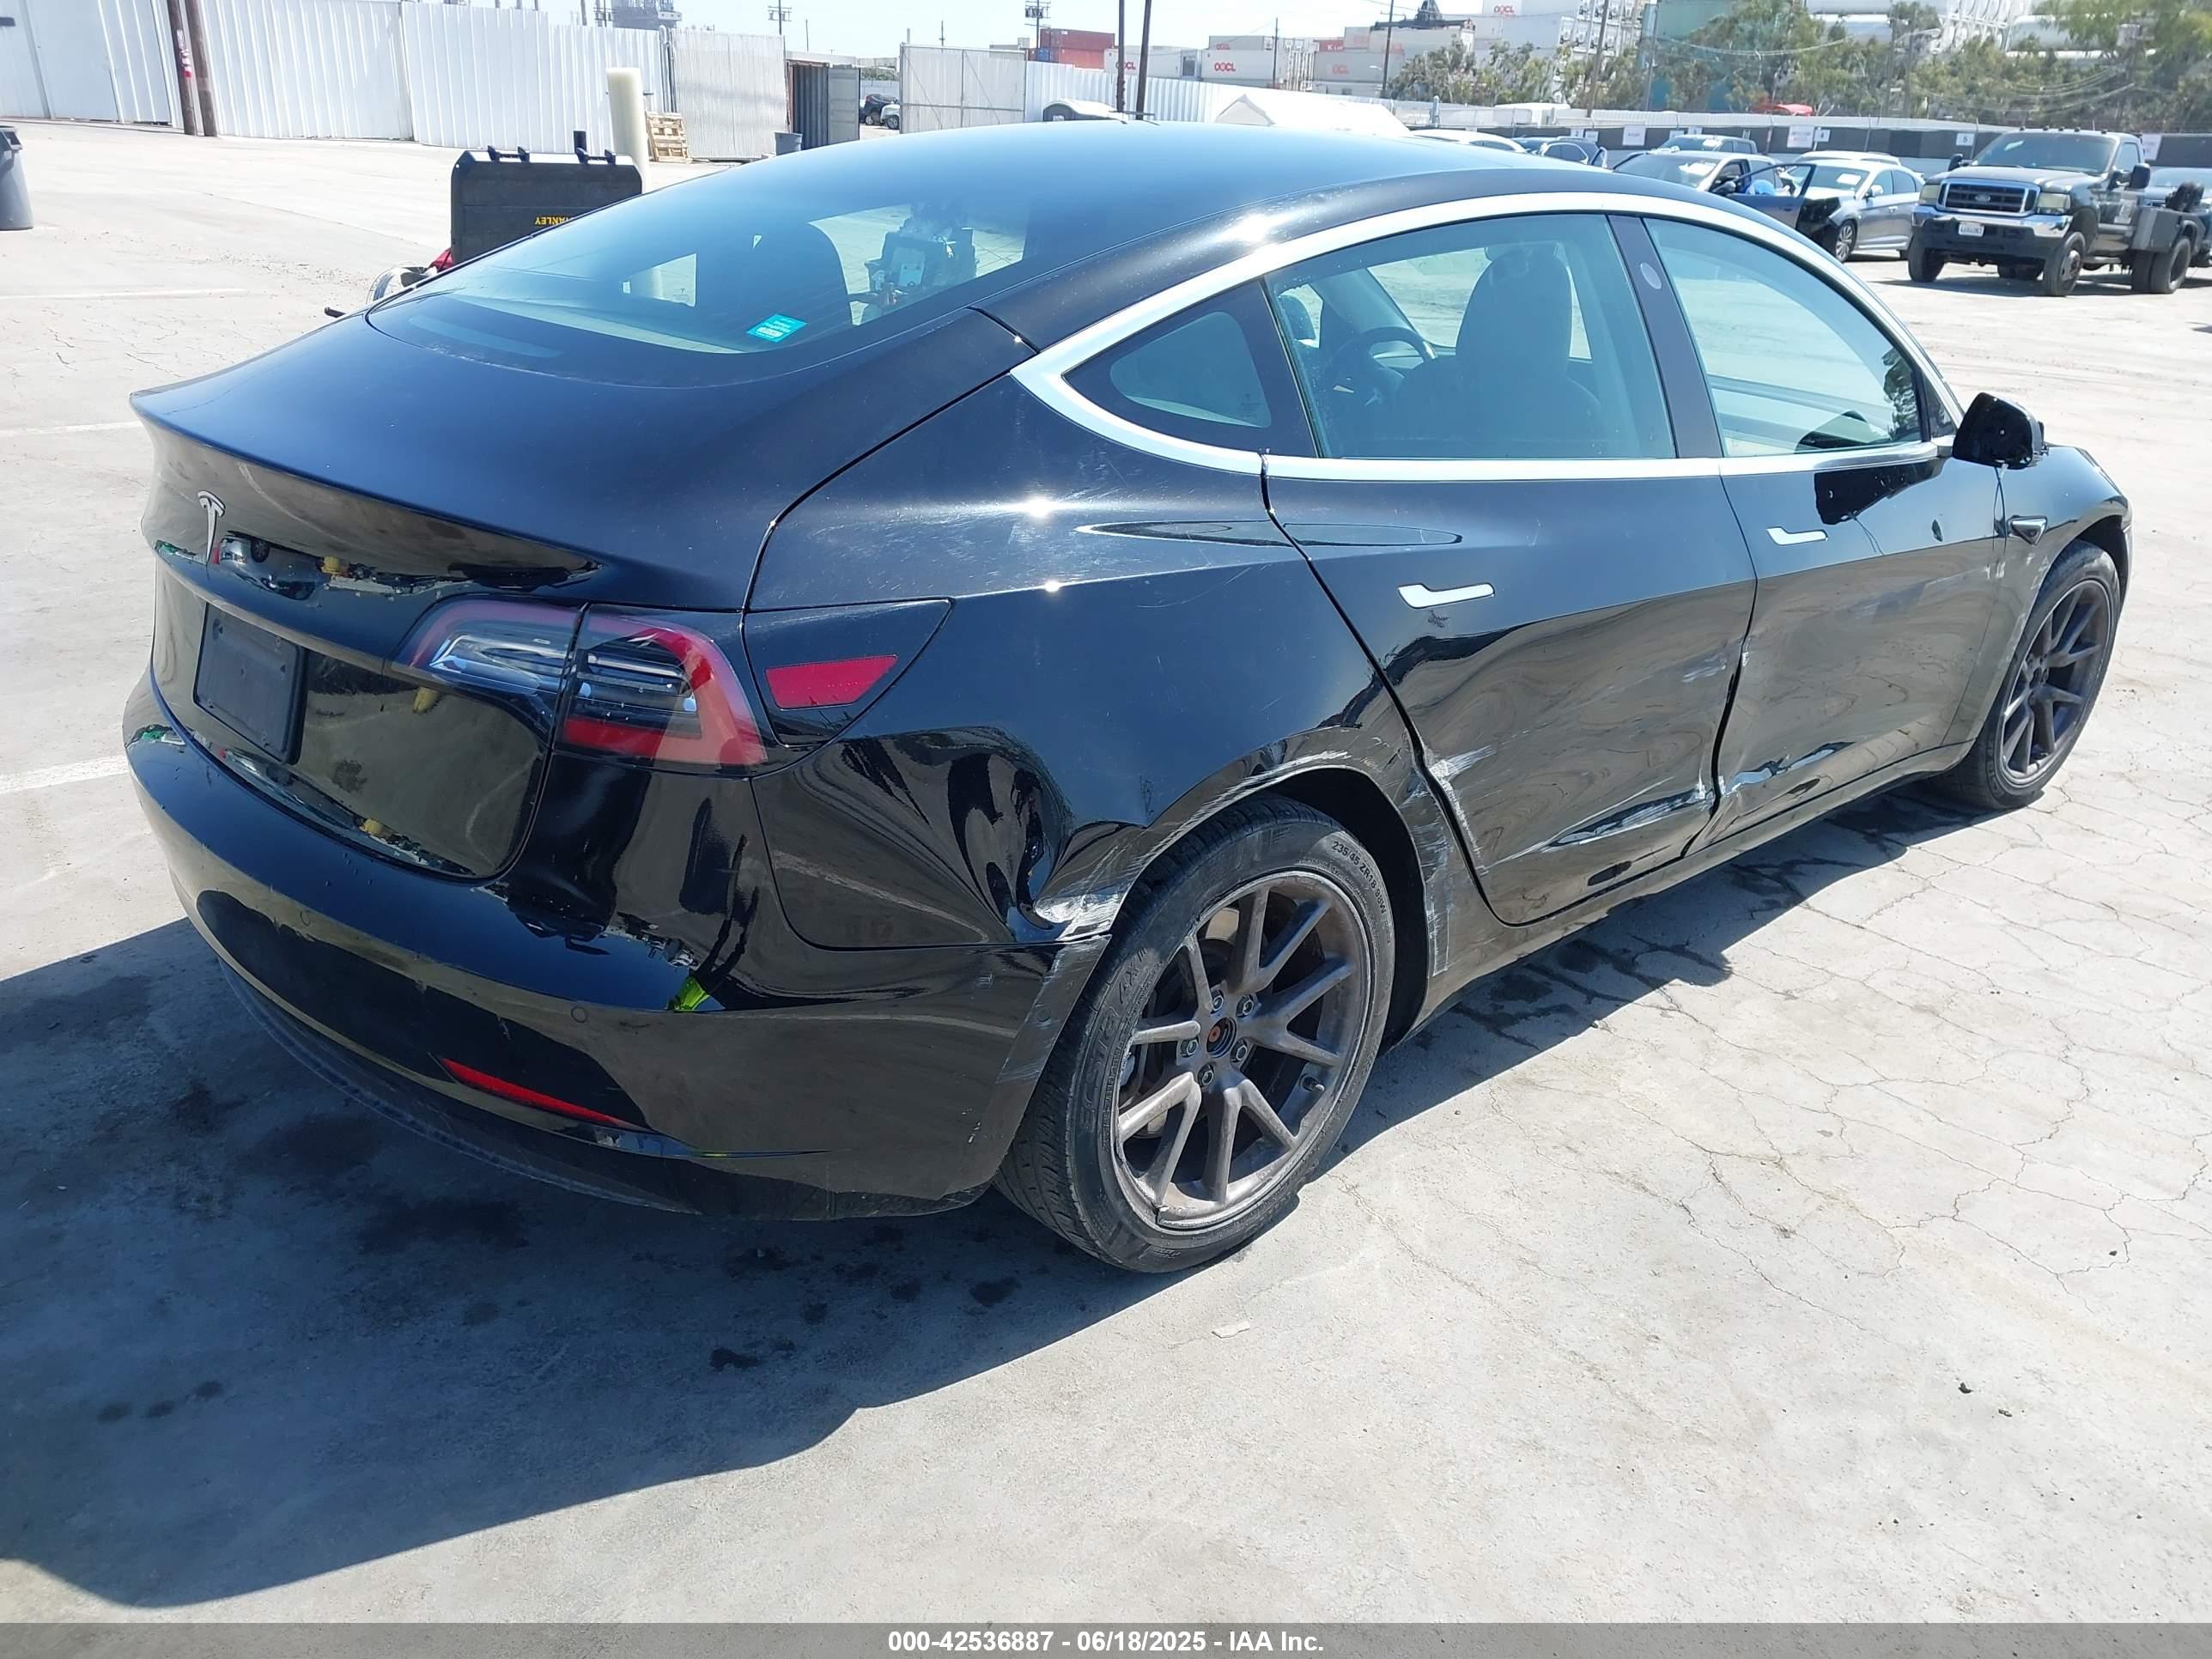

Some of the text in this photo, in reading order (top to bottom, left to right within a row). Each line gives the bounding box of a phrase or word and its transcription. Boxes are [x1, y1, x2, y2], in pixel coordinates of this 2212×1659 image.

[1493, 5, 1515, 14] OOCL
[1214, 63, 1236, 72] OOCL
[1332, 841, 1361, 866] 235/45
[1359, 862, 1377, 889] ZR18
